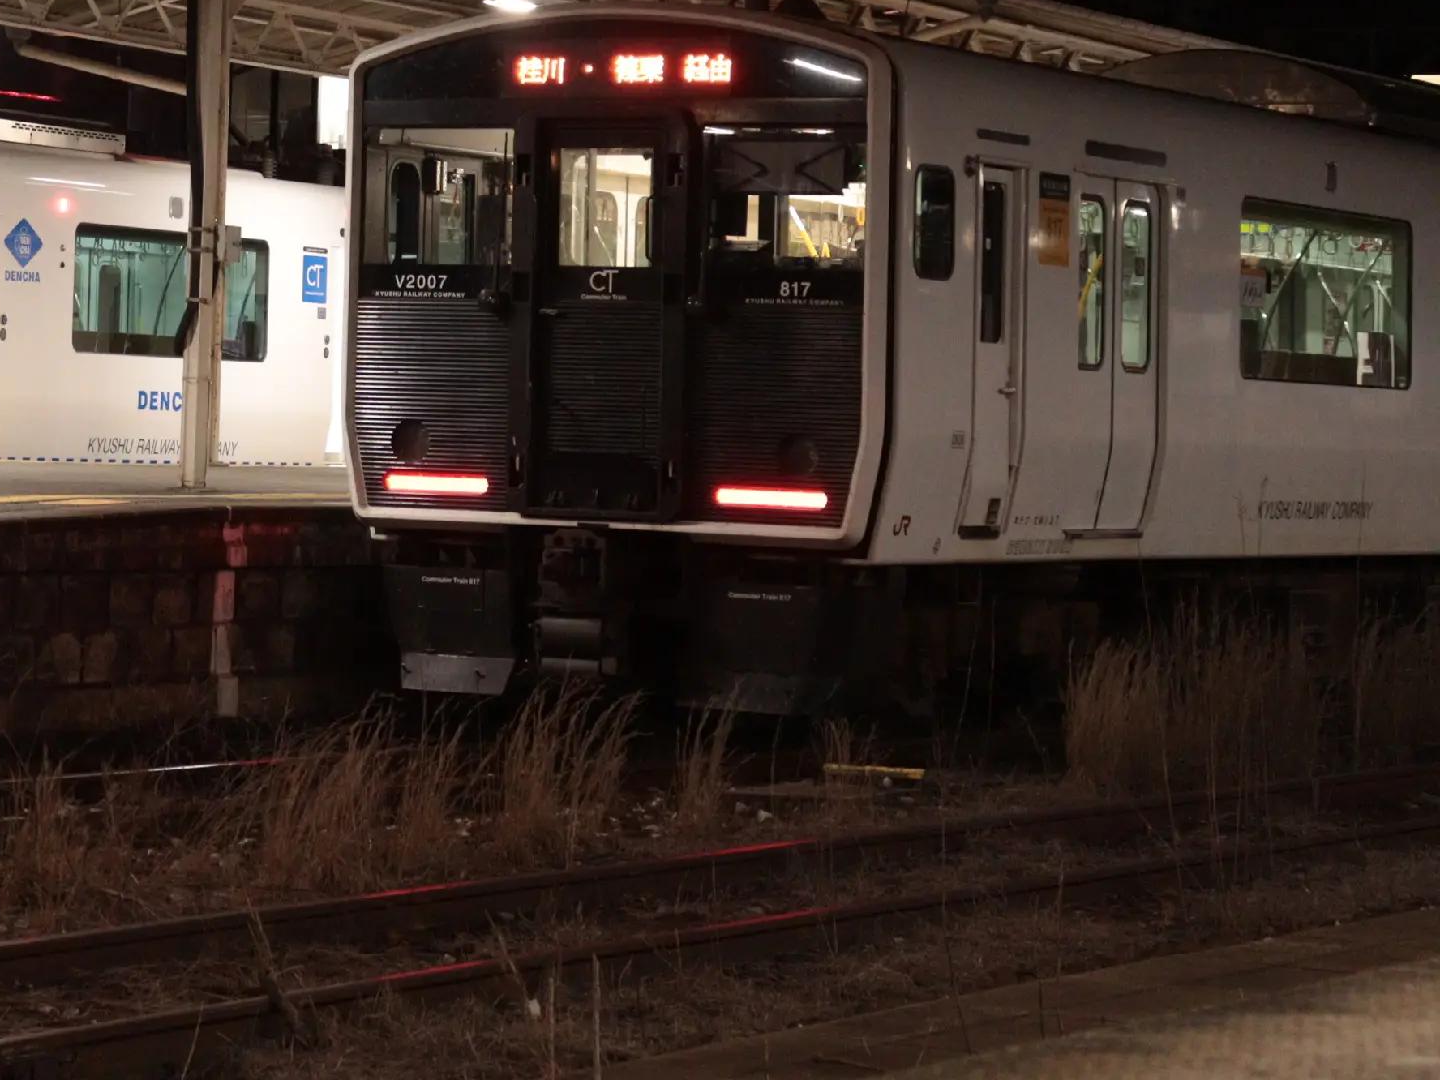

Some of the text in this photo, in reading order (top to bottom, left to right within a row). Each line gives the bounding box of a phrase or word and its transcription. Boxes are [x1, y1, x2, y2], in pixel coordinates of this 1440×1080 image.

[4, 270, 41, 282] DENCHA
[306, 263, 325, 289] CT
[395, 274, 448, 289] V2007
[589, 269, 620, 294] CT
[780, 281, 812, 297] 817
[137, 390, 183, 412] DENC
[87, 436, 134, 455] KYUSHU
[893, 515, 912, 537] JR
